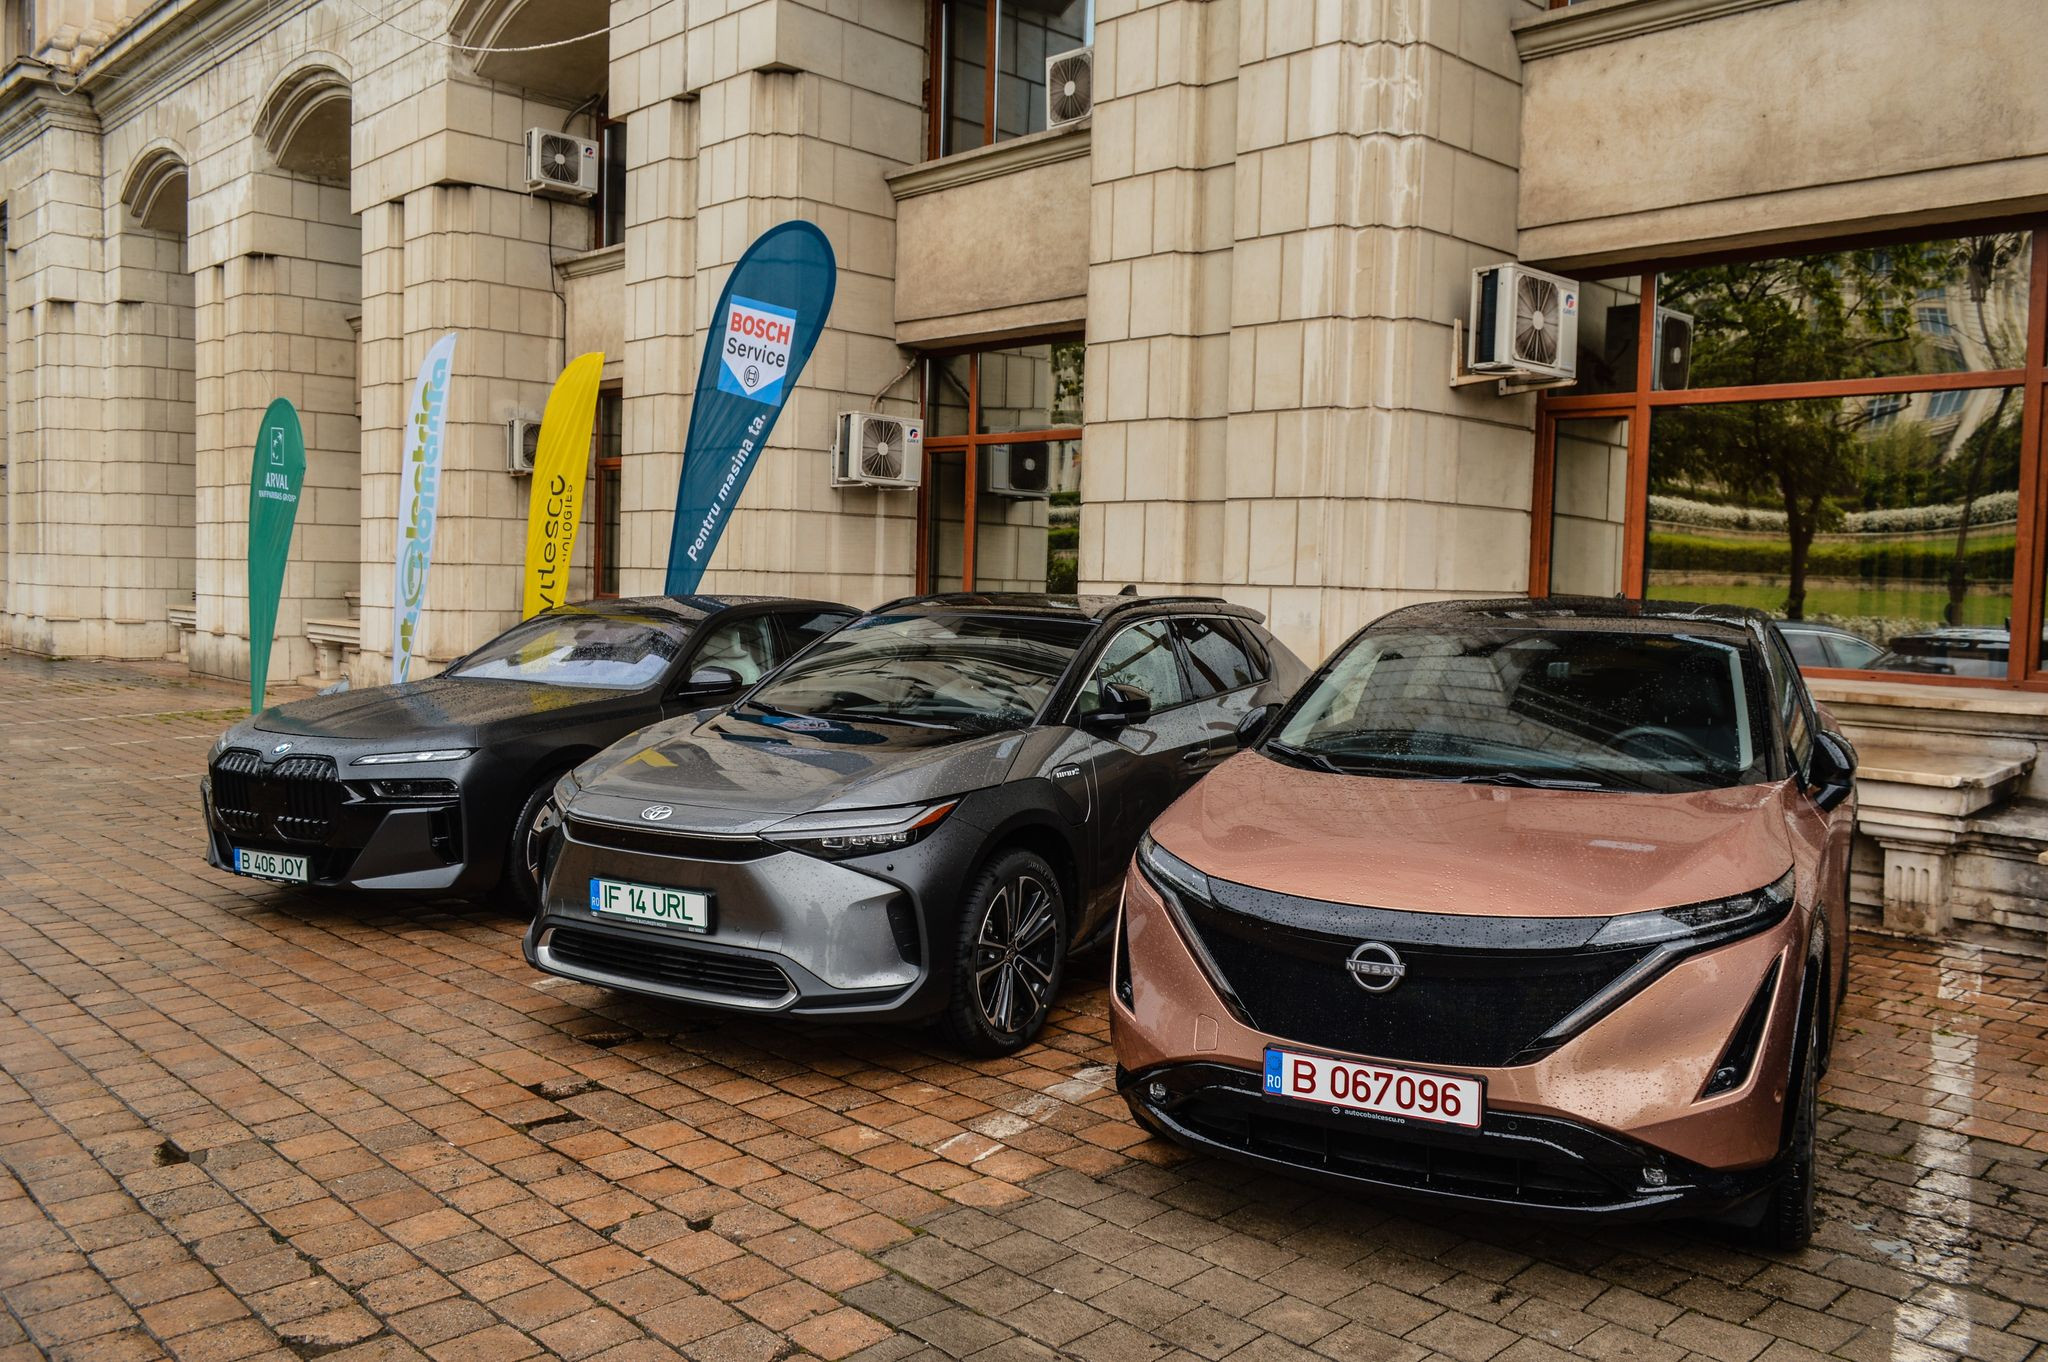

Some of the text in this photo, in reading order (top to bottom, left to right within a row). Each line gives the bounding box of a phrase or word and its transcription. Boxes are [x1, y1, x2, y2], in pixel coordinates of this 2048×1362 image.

[730, 311, 791, 346] BOSCH
[726, 337, 786, 368] Service
[411, 358, 447, 570] Romania
[265, 472, 289, 491] ARVAL
[687, 502, 721, 562] Pentru
[718, 438, 755, 502] masina
[748, 414, 767, 437] ta.
[241, 852, 251, 870] B
[255, 855, 276, 874] 406
[278, 857, 303, 877] JOY
[591, 896, 600, 907] RO
[604, 884, 693, 921] IF 14 URL
[1346, 960, 1405, 977] NISSAN
[1267, 1074, 1281, 1089] RO
[1292, 1059, 1462, 1117] B 067096
[1344, 1109, 1406, 1124] autocobalcescu.ro
